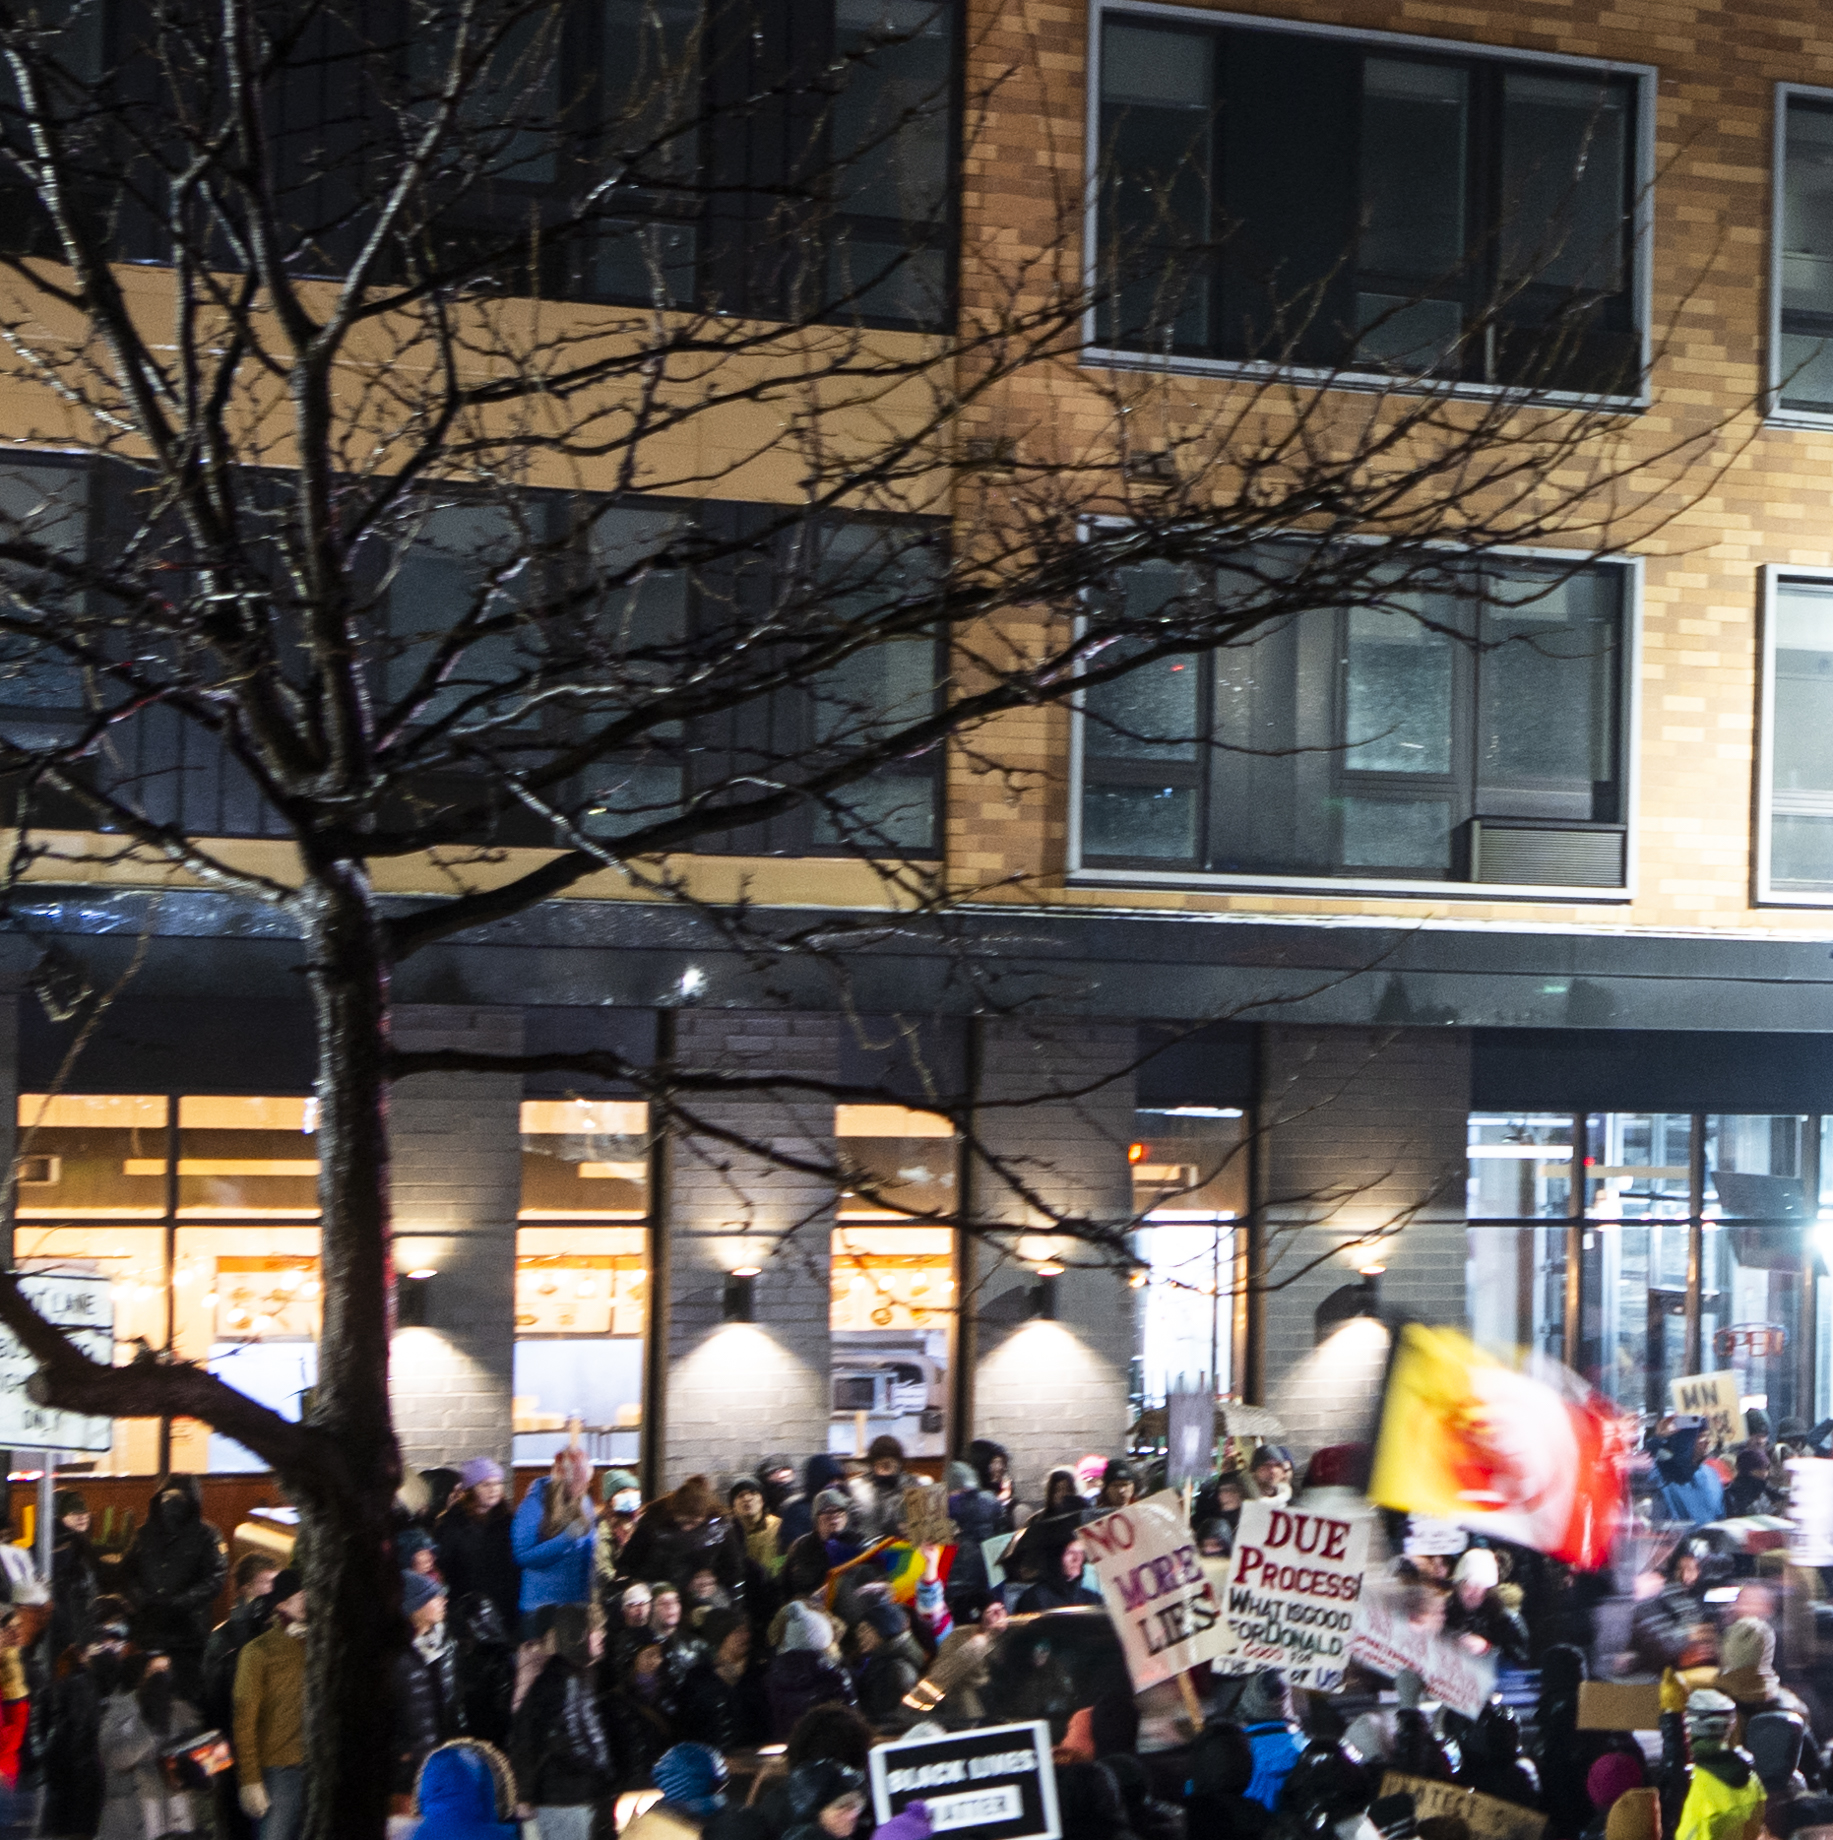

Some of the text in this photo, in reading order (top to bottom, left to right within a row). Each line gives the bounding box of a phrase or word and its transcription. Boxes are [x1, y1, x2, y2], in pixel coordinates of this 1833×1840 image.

[1079, 1512, 1136, 1564] NO
[1264, 1509, 1352, 1562] DUE
[1112, 1545, 1205, 1613] MORE
[1229, 1587, 1285, 1623] WHAT
[1265, 1619, 1343, 1657] DONALD
[886, 1749, 1039, 1795] BLACK LIVES
[930, 1796, 1006, 1826] ATTER
